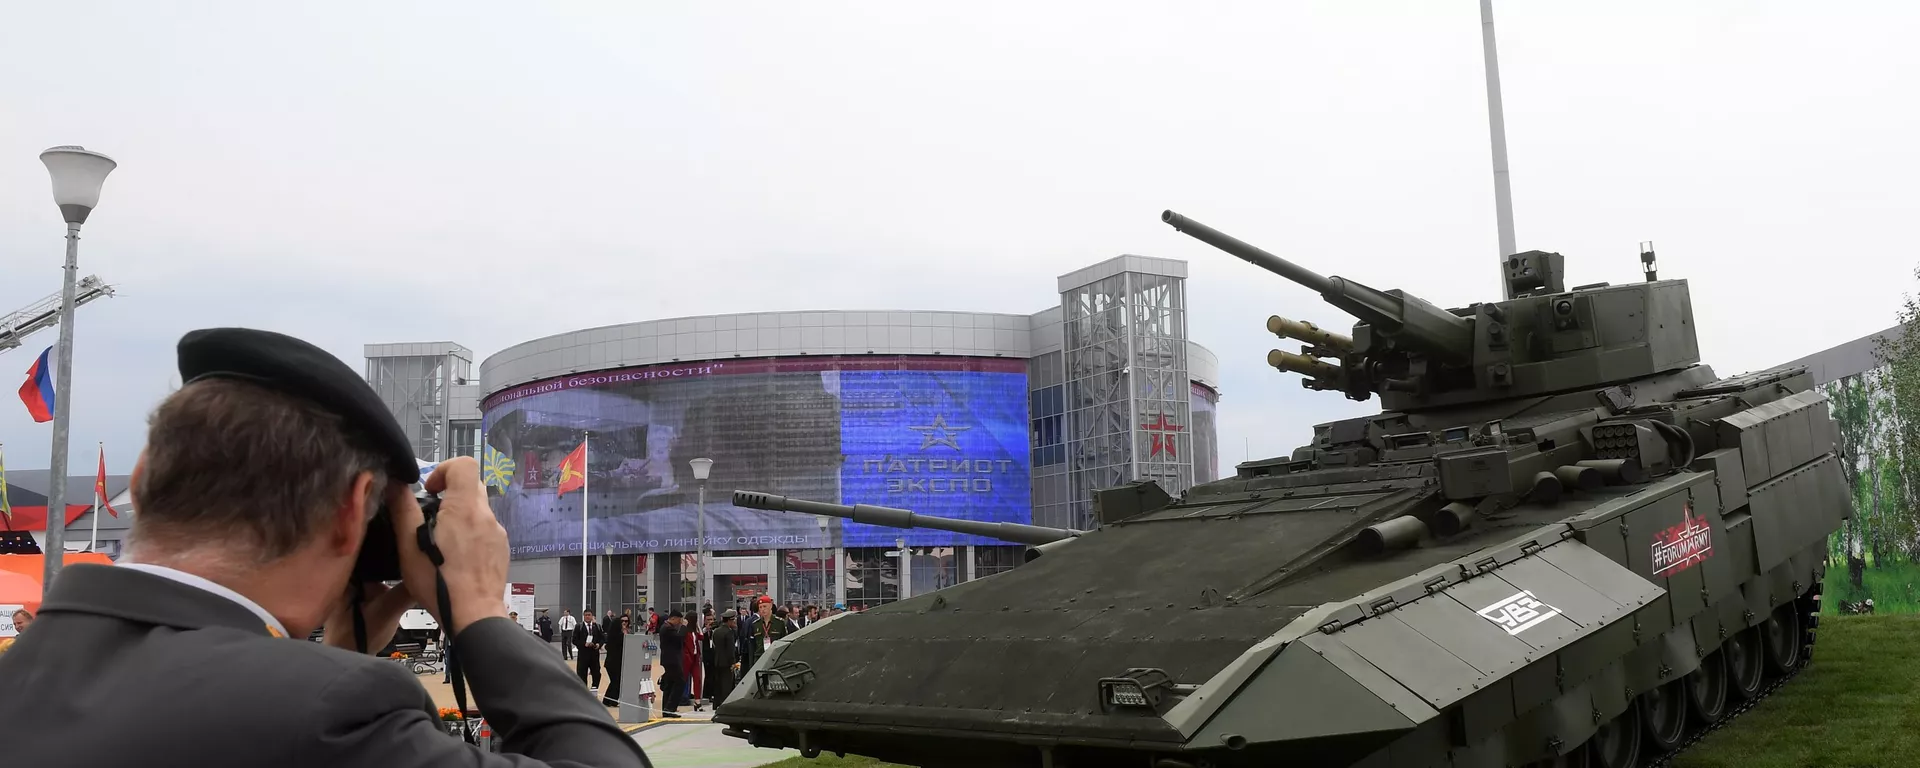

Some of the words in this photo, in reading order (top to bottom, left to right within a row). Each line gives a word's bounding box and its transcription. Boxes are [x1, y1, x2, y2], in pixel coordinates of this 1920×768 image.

[863, 459, 1012, 474] ПАТРИОТ
[886, 477, 993, 493] ЭКСПО
[517, 544, 555, 555] ИГРУШКИ
[558, 543, 565, 551] И
[568, 540, 659, 551] СПЦИЛЬНУЮ
[663, 535, 732, 547] ЛИНЕЙКУ
[737, 535, 808, 546] ОДЕЖДЫ
